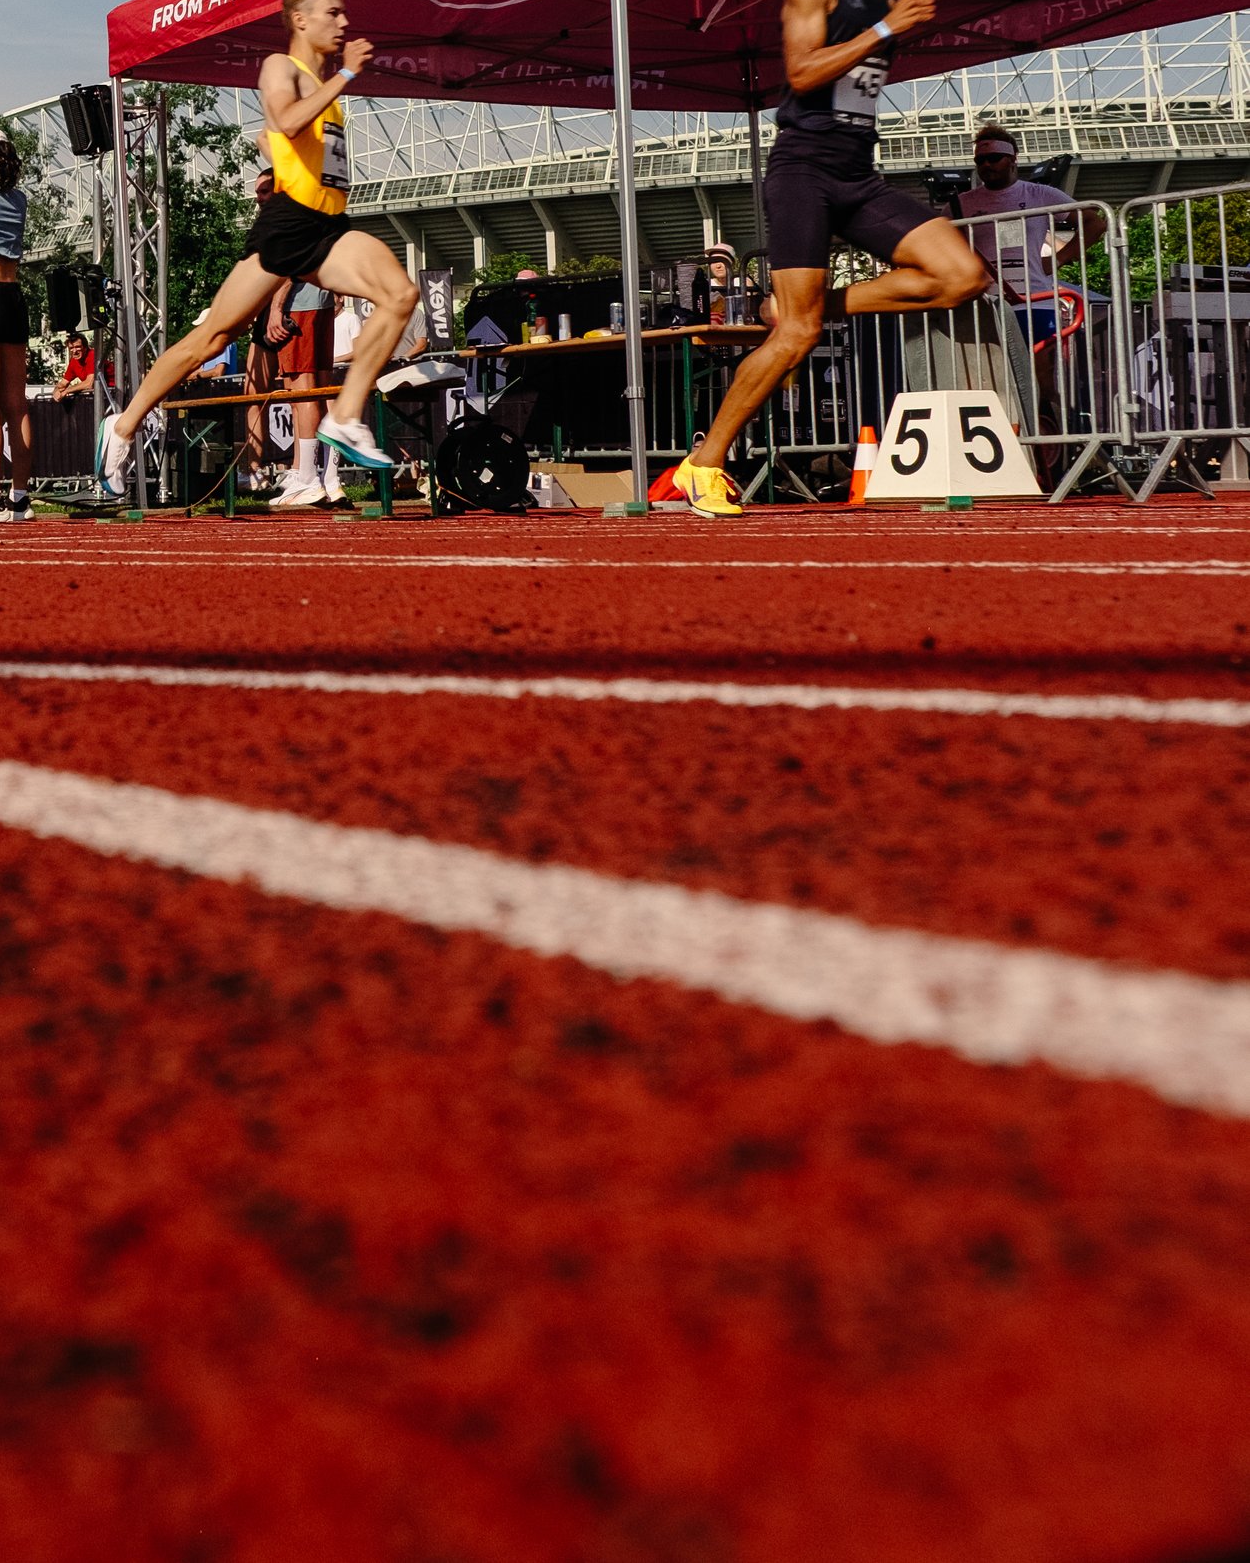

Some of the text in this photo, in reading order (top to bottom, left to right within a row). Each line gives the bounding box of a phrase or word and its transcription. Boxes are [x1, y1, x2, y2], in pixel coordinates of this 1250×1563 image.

[427, 279, 450, 339] uvex
[272, 406, 294, 438] TN
[890, 408, 932, 477] 5
[958, 406, 1005, 474] 5
